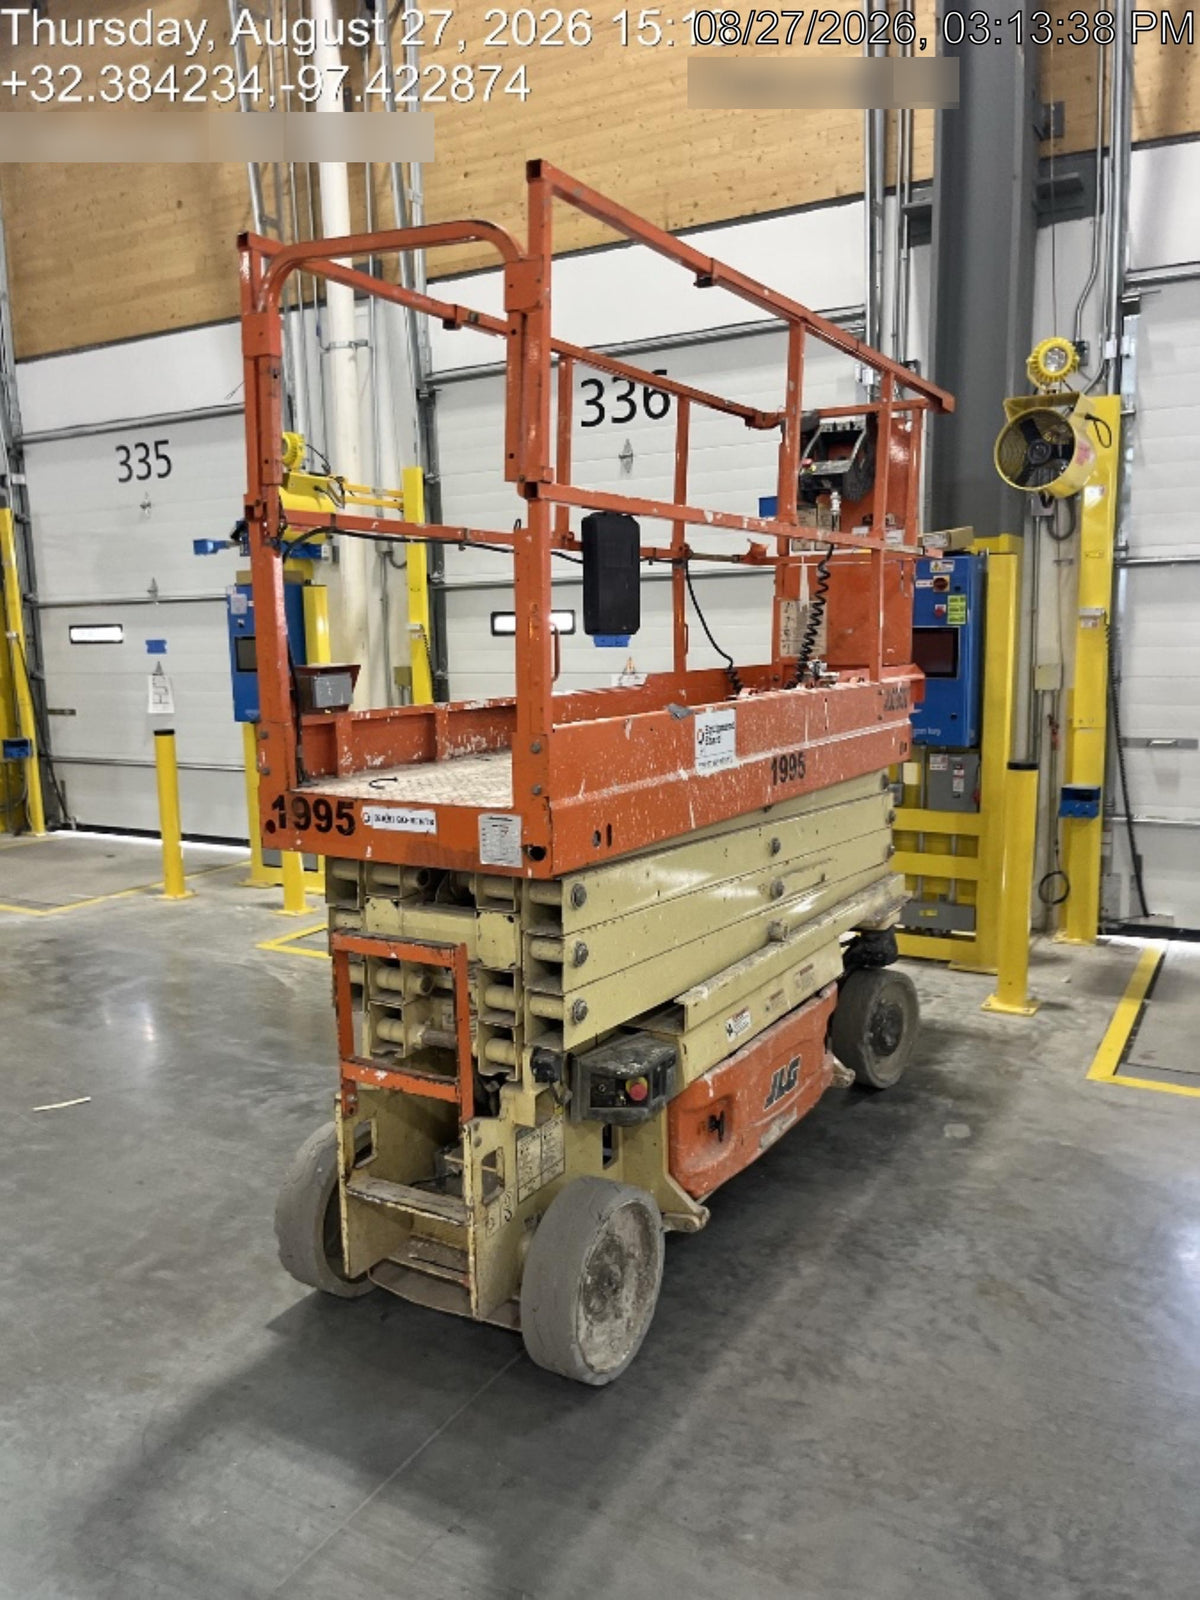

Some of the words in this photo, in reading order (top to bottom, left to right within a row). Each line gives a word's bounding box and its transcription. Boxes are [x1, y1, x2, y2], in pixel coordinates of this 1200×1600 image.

[580, 369, 671, 427] 336
[115, 439, 172, 483] 335
[771, 752, 806, 786] 1995
[272, 794, 356, 835] 1995
[763, 1053, 801, 1111] JLG
